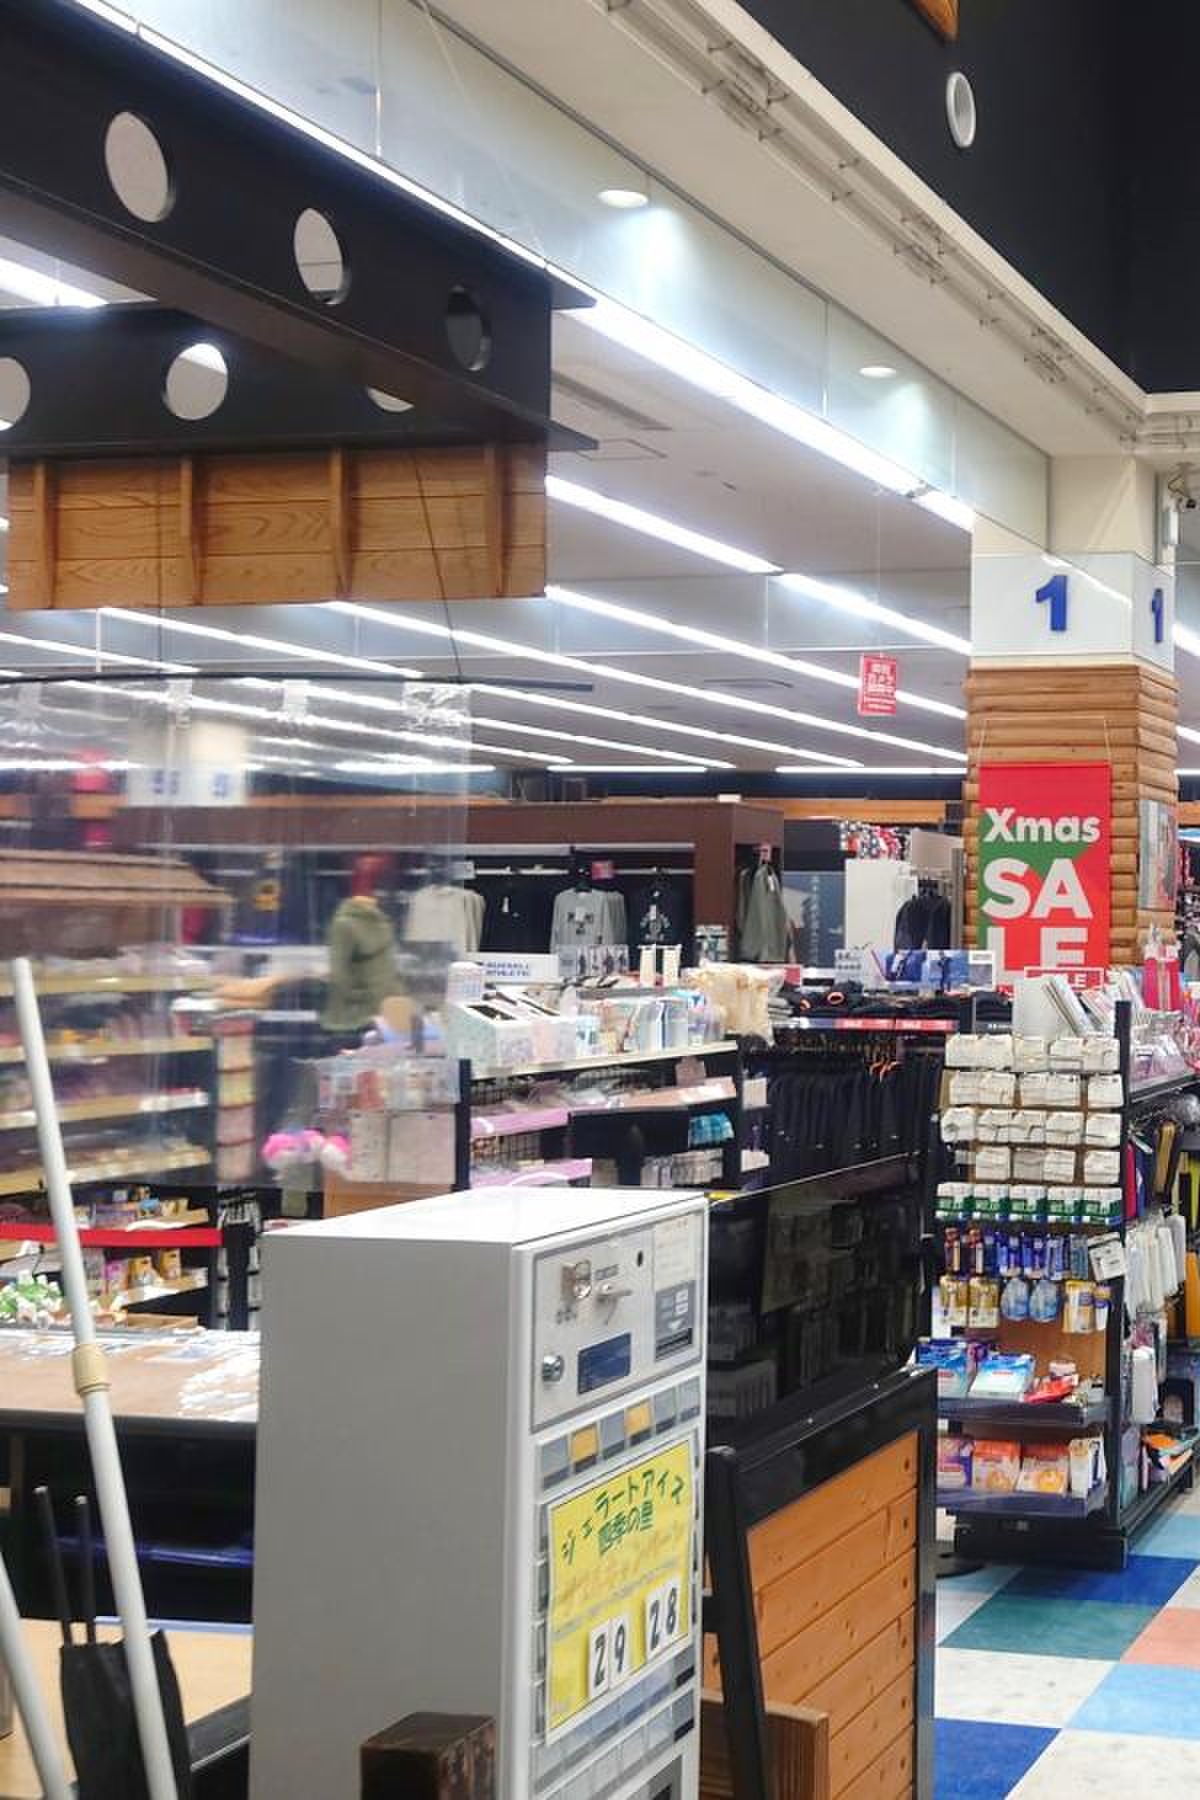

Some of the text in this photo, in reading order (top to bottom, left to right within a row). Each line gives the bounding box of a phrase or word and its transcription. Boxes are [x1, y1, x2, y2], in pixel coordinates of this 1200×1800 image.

[1035, 574, 1067, 632] 1
[1151, 588, 1164, 643] 1
[982, 807, 1101, 843] Xmas
[981, 856, 1094, 920] SA
[593, 1623, 626, 1688] 29
[650, 1586, 677, 1651] 28
